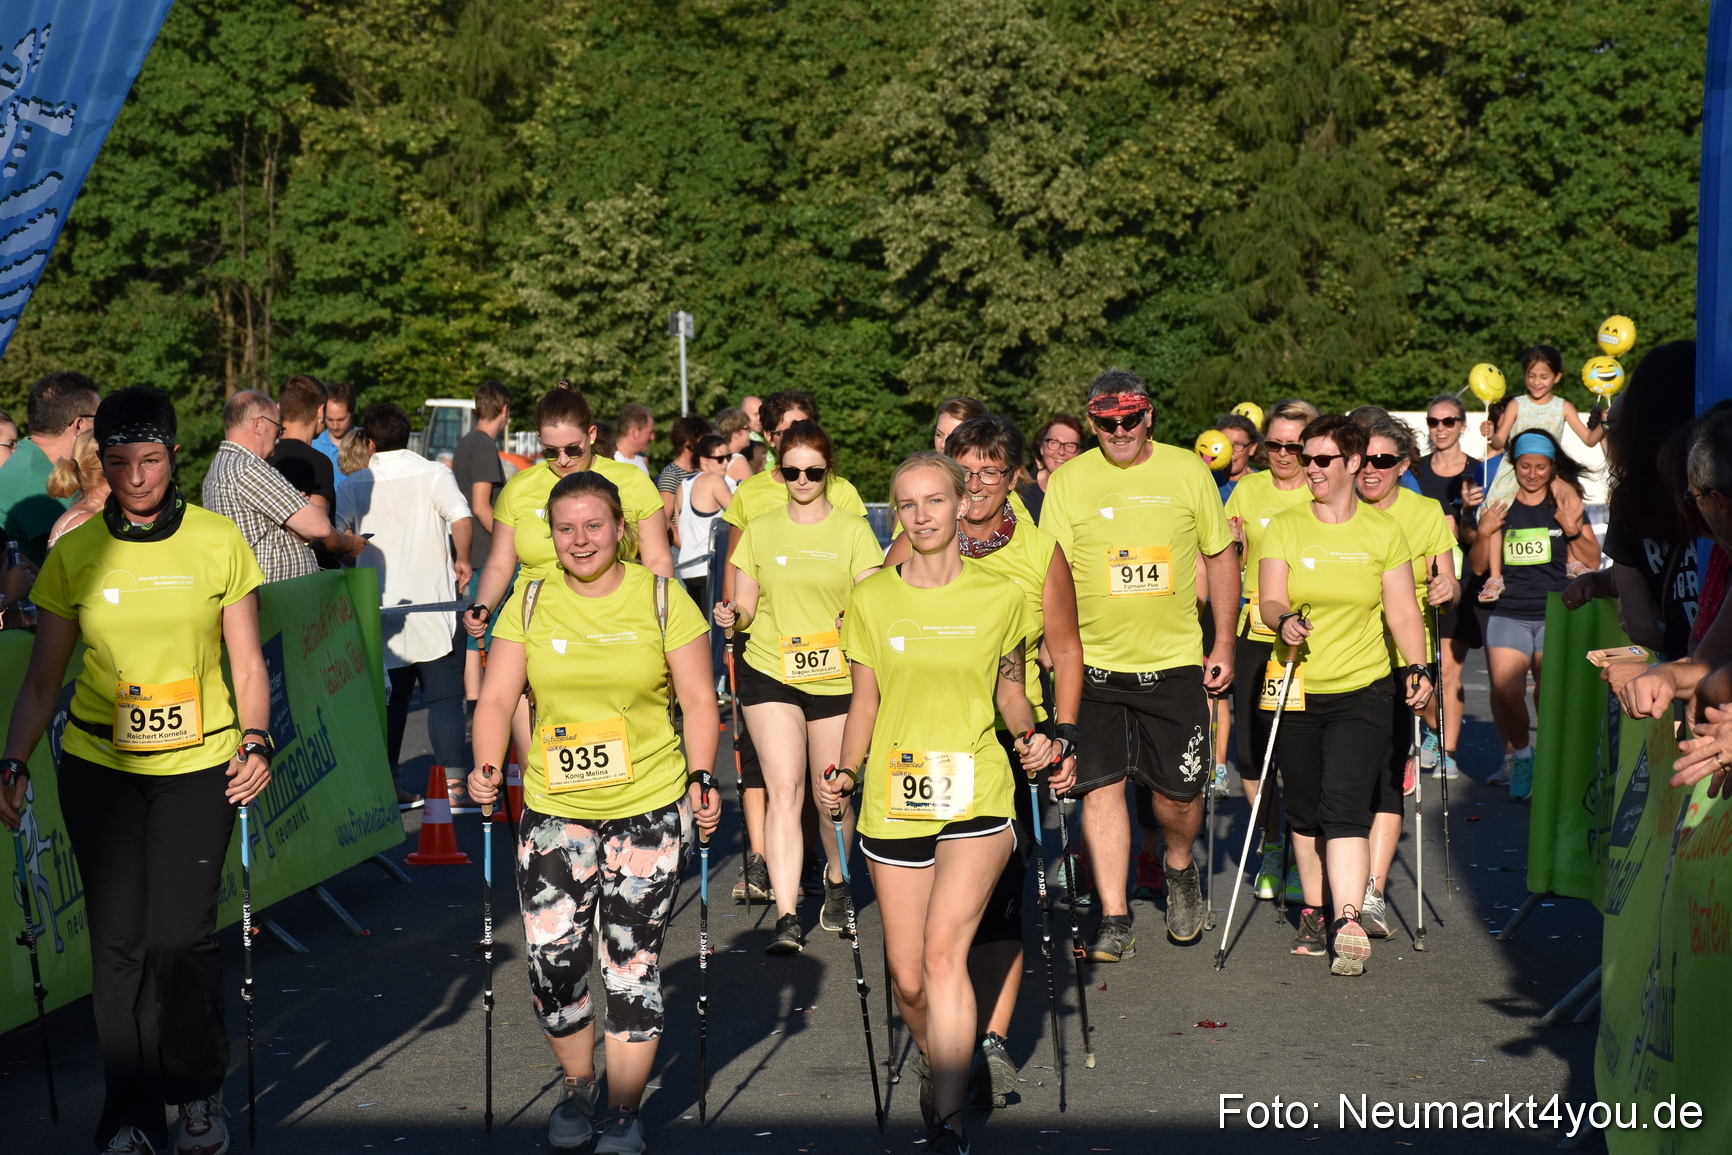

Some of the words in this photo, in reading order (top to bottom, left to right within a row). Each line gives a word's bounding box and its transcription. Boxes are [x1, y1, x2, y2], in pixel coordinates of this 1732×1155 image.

[1508, 541, 1544, 555] 1063
[1121, 564, 1160, 584] 914
[794, 648, 830, 670] 967
[130, 706, 183, 732] 955
[127, 732, 157, 740] Reichert
[159, 730, 188, 739] Kornelia
[559, 744, 609, 773] 935
[565, 772, 584, 780] König
[586, 769, 608, 777] Melina
[903, 776, 952, 800] 962
[274, 800, 310, 847] neumarkt
